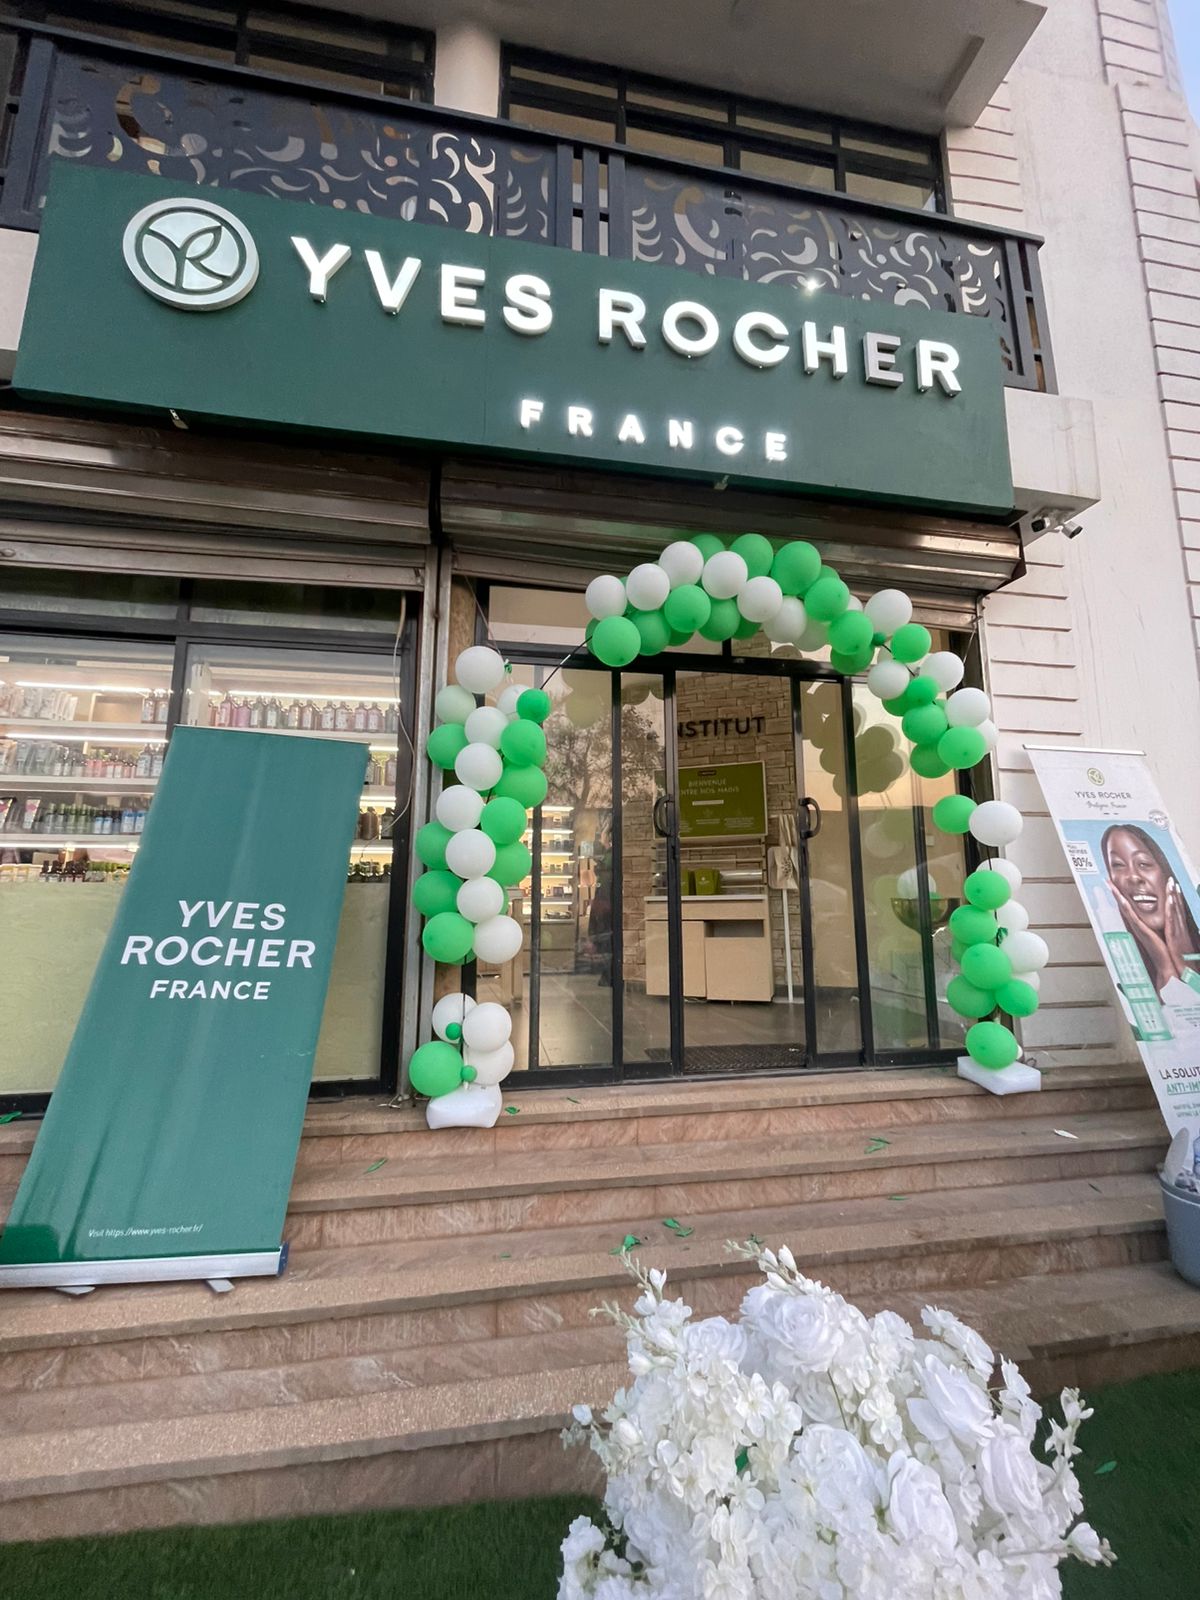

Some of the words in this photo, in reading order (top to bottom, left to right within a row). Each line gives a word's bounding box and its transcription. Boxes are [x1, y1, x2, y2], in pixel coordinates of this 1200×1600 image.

[290, 235, 555, 336] YVES
[597, 288, 964, 397] ROCHER
[519, 397, 791, 463] FRANCE
[1074, 791, 1097, 799] YVES
[1097, 791, 1132, 799] ROCHER
[178, 900, 287, 931] YVES
[120, 935, 316, 968] ROCHER
[150, 979, 271, 1000] FRANCE
[1159, 1069, 1172, 1080] LA
[1167, 1081, 1200, 1093] ANTI-IM
